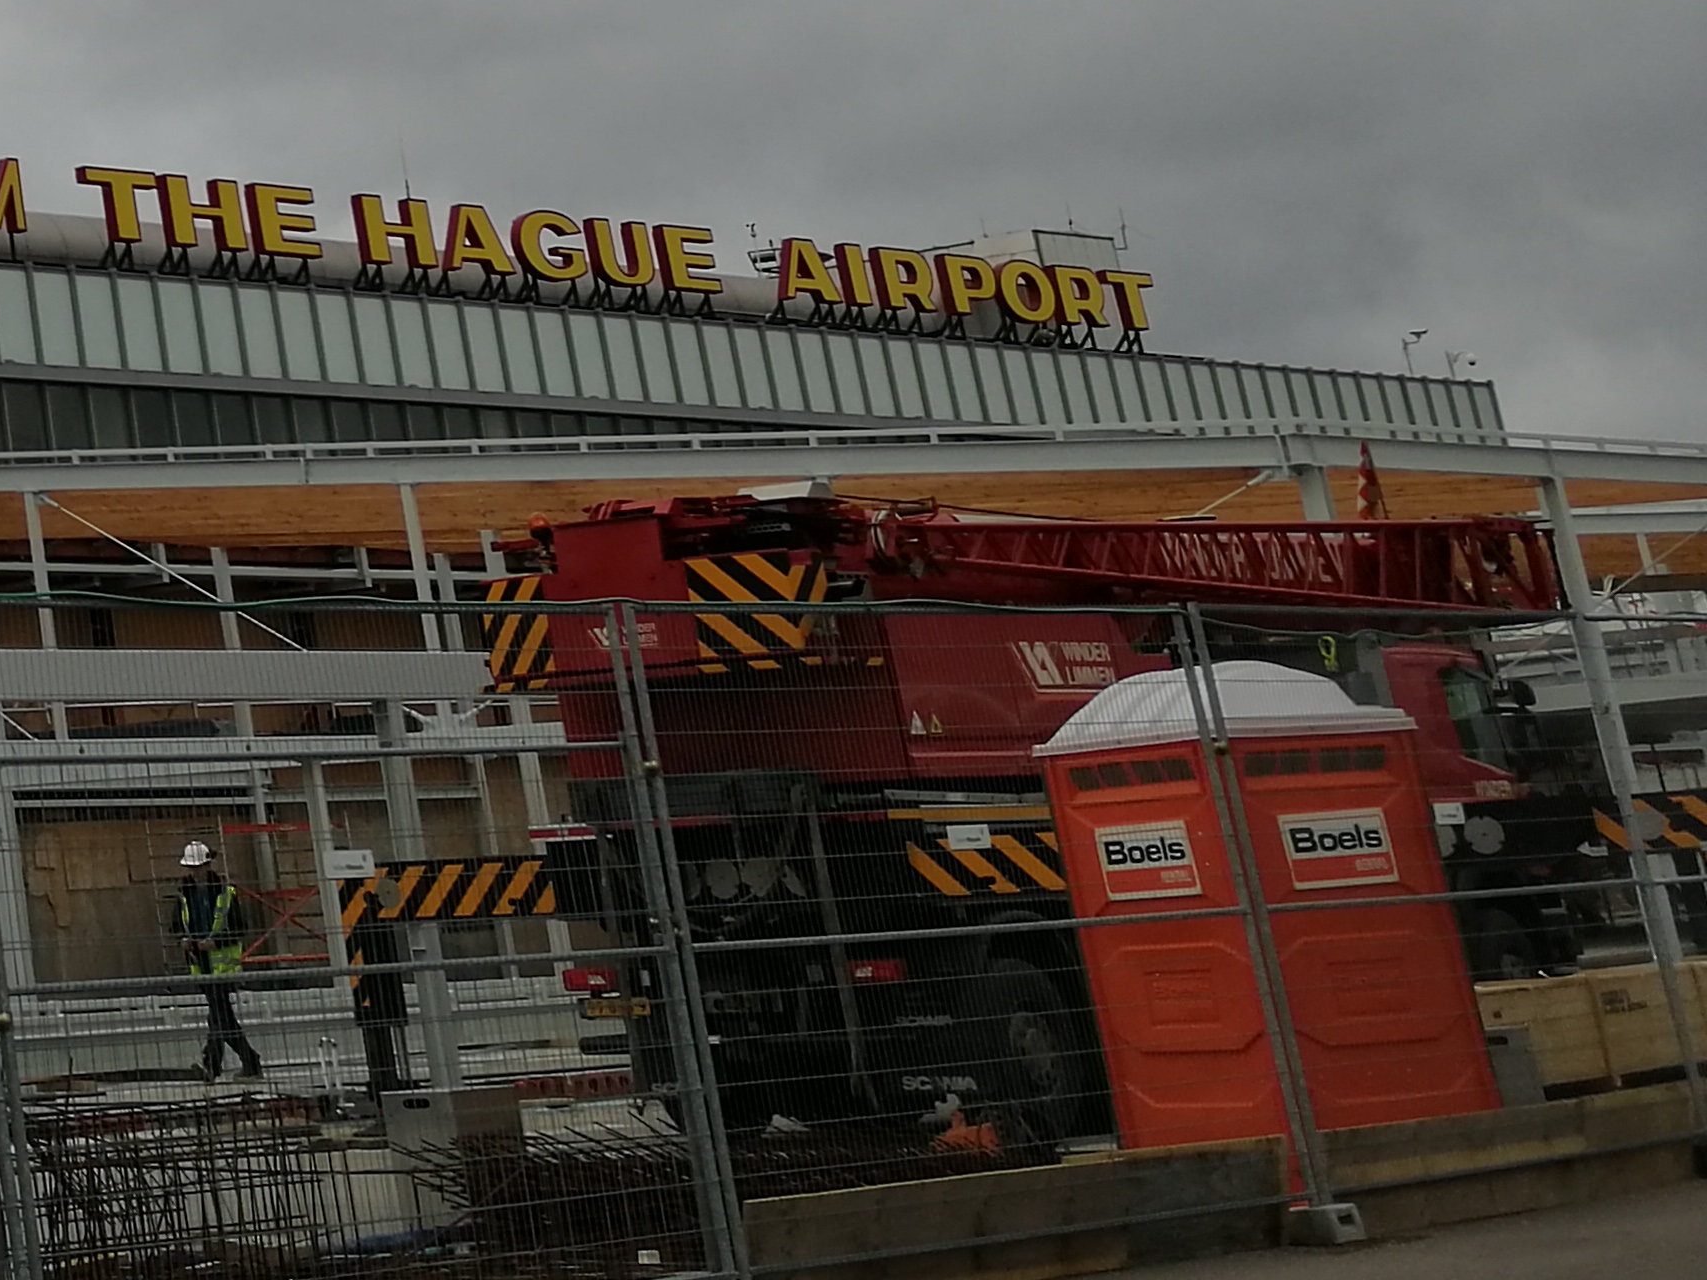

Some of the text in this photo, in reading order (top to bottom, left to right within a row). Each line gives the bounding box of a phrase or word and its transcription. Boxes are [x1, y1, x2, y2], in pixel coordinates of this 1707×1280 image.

[75, 165, 324, 259] THE
[351, 193, 724, 294] HAGUE
[778, 237, 1154, 331] AIRPORT
[1103, 836, 1186, 865] Boels
[1289, 823, 1383, 853] Boels
